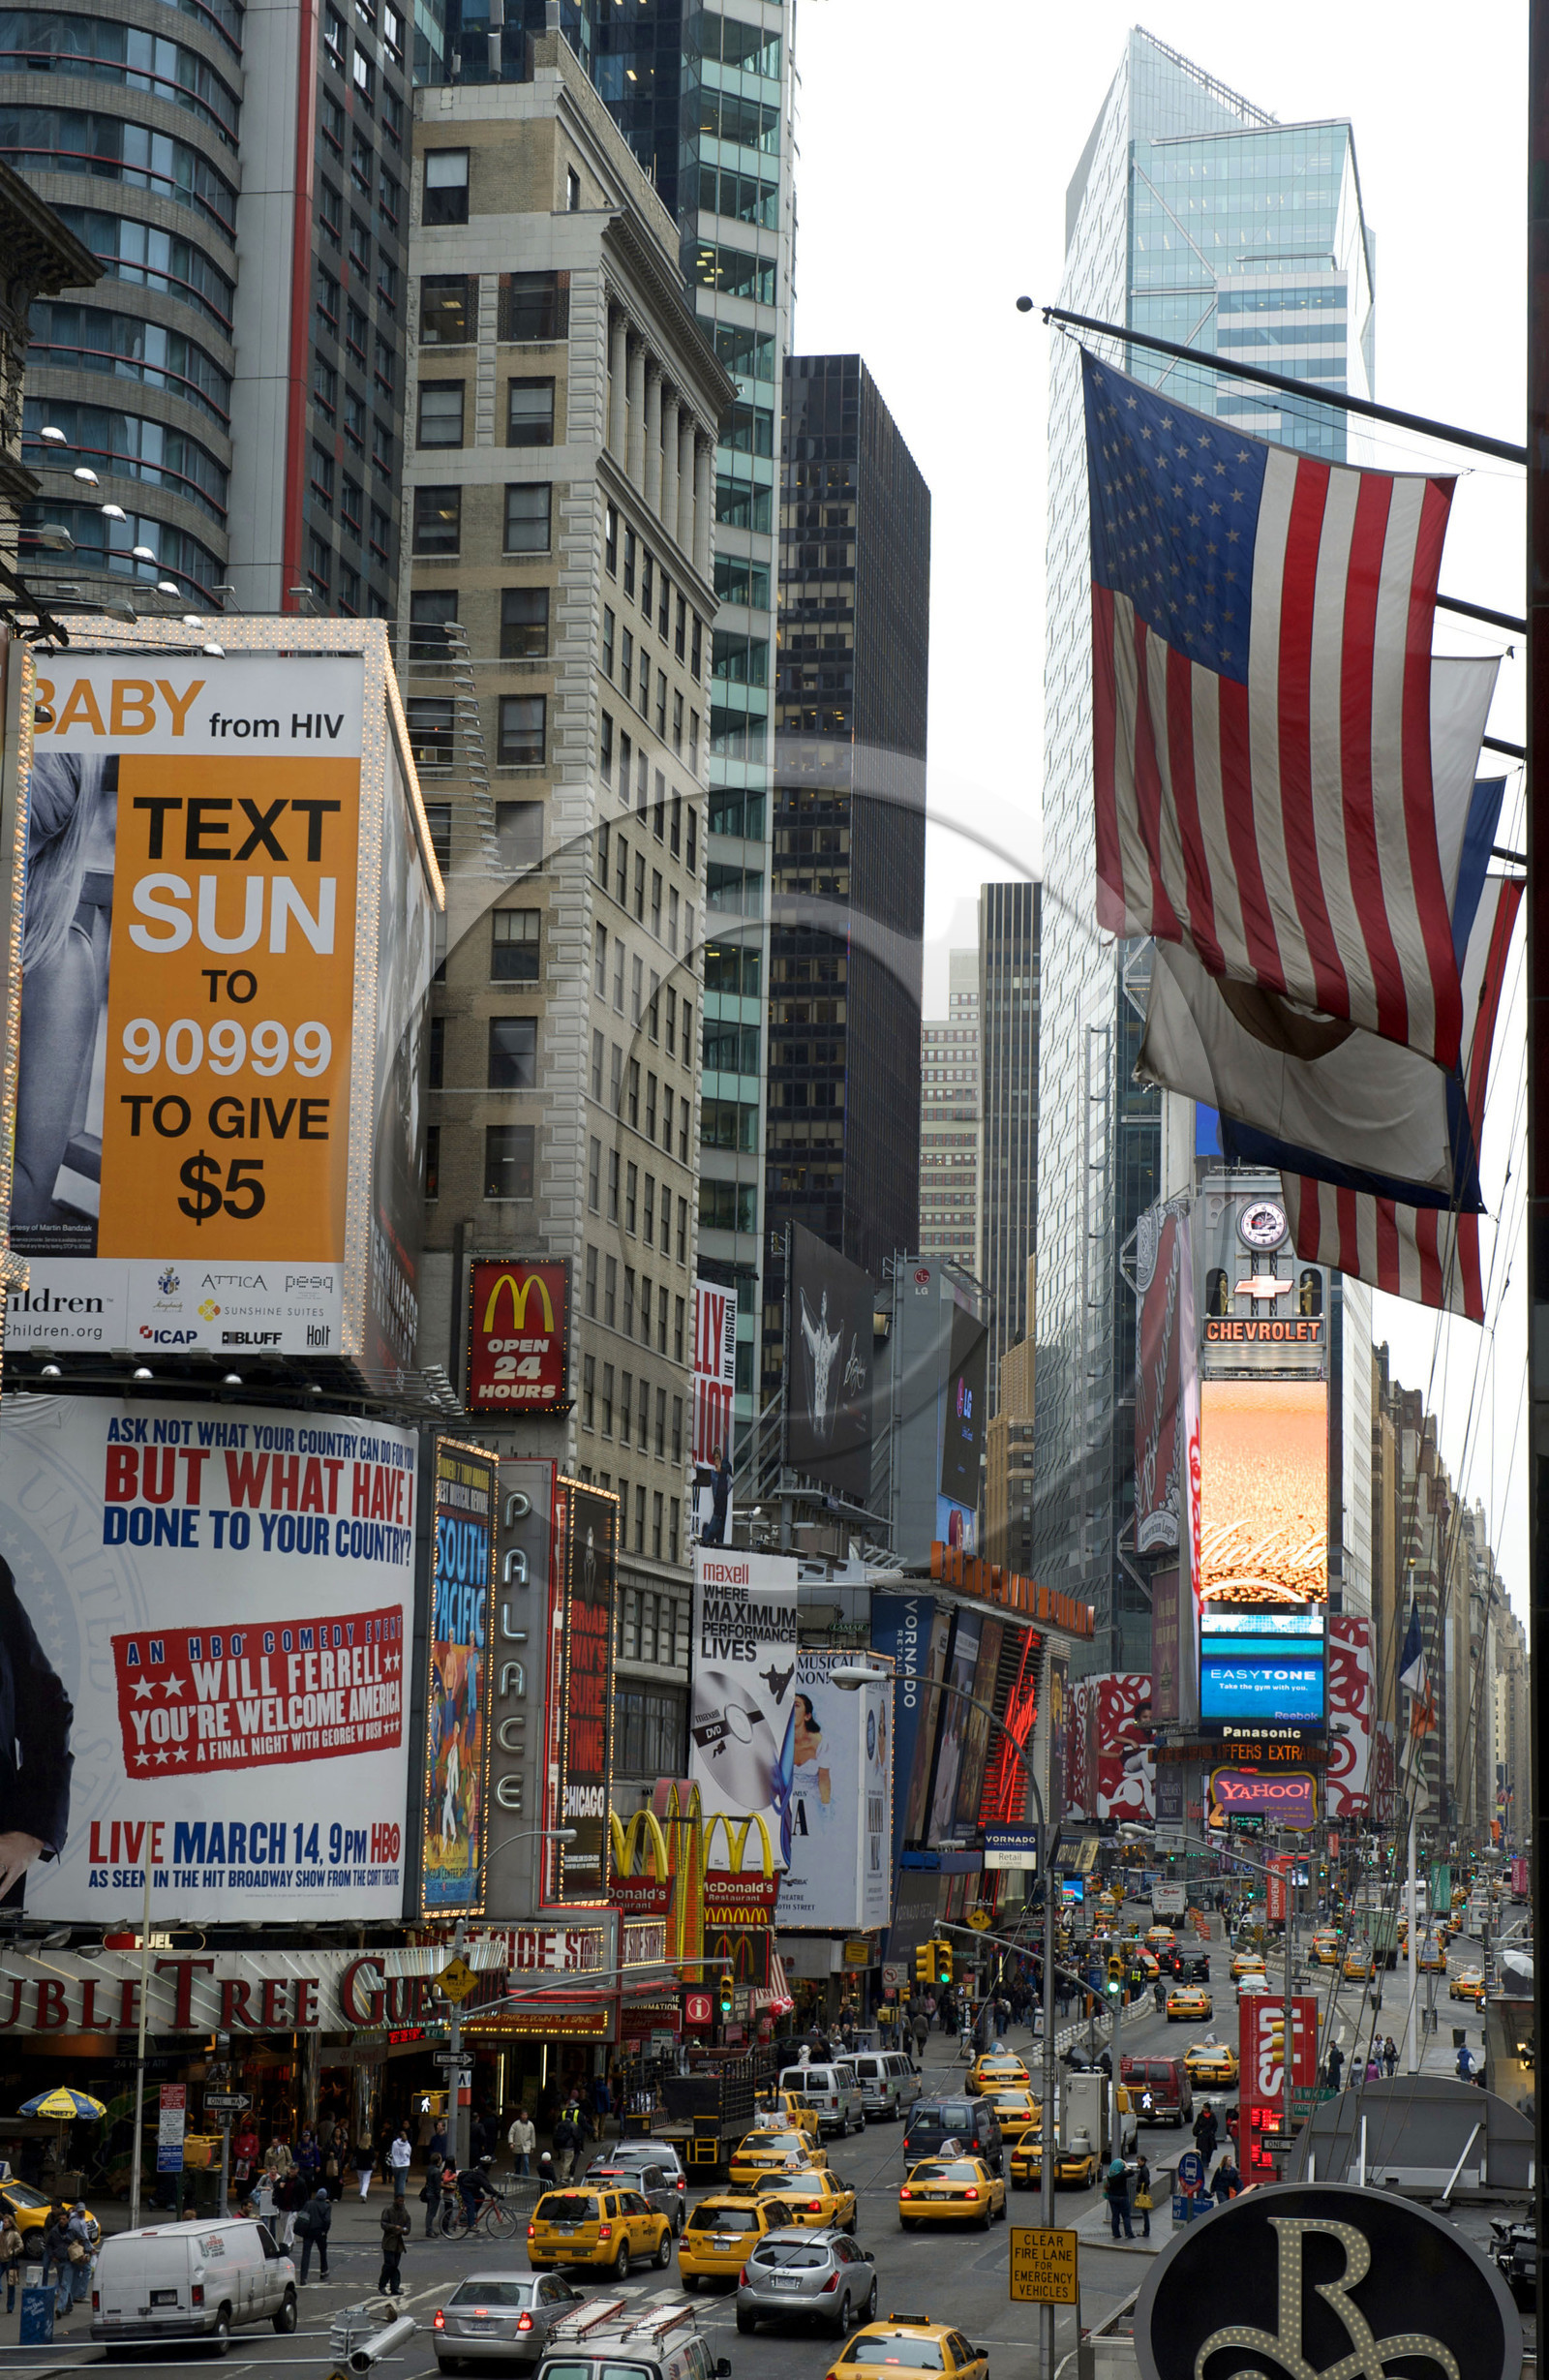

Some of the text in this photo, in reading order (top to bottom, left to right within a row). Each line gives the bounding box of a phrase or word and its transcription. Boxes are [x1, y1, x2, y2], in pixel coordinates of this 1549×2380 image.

[34, 678, 345, 739] BABY from HIV
[133, 797, 341, 862] TEXT
[128, 872, 337, 955] SUN
[201, 969, 258, 1004] TO
[122, 1018, 333, 1078] 90999
[120, 1095, 330, 1140] TO GIVE
[177, 1149, 265, 1226] $5
[200, 1274, 268, 1291] ATTICA
[915, 1287, 929, 1296] LG
[225, 1306, 324, 1317] SUNSHINE SUITES
[154, 1329, 197, 1344] ICAP
[235, 1331, 283, 1345] BLUFF
[306, 1325, 331, 1346] Holt
[724, 1298, 736, 1380] THE MUSICAL
[1206, 1322, 1321, 1341] CHEVROLET
[487, 1338, 549, 1353] OPEN
[493, 1356, 542, 1380] 24
[478, 1384, 557, 1399] HOURS
[107, 1418, 414, 1470] ASK NOT WHAT YOUR COUNTRY CAN DO FOR YOU
[104, 1445, 413, 1527] BUT WHAT HAVE I
[103, 1507, 411, 1567] DONE TO YOUR COUNTRY?
[437, 1515, 488, 1586] SOUTH
[703, 1562, 749, 1585] maxell
[704, 1584, 749, 1602] WHERE
[434, 1578, 486, 1647] PACIFIC
[702, 1600, 797, 1629] MAXIMUM
[127, 1639, 166, 1666] AN
[263, 1623, 354, 1654] COMEDY
[365, 1616, 402, 1642] EVENT
[702, 1623, 796, 1644] PERFORMANCE
[495, 1490, 532, 1811] PALACE
[701, 1636, 757, 1663] LIVES
[903, 1599, 918, 1708] VORNADO
[192, 1644, 382, 1702] WILL FERRELL
[1210, 1669, 1317, 1680] EASYTONE
[570, 1672, 604, 1717] SURE
[129, 1680, 401, 1747] YOU'RE WELCOME AMERICA
[695, 1709, 720, 1724] maxell
[1274, 1711, 1318, 1721] Reebok
[197, 1722, 382, 1762] A FINAL NIGHT WITH GEORGE W BUSH
[706, 1725, 722, 1740] DVD
[1223, 1726, 1301, 1739] Panasonic
[569, 1718, 603, 1773] THING
[563, 1785, 604, 1818] CHICAGO
[1219, 1781, 1311, 1800] YAHOO!
[89, 1820, 401, 1867] LIVE MARCH 14, HBO
[998, 1852, 1022, 1861] Retail
[89, 1869, 400, 1888] AS SEEN IN THE HIT BROADWAY SHOW FROM THE CORT THEATRE
[607, 1887, 667, 1902] Donald's
[709, 1893, 761, 1903] Restaurant
[135, 1934, 173, 1949] FUEL
[154, 1957, 320, 2030] TREE
[1023, 2234, 1064, 2247] CLEAR
[1016, 2247, 1073, 2261] FIRE LANE
[1015, 2271, 1073, 2284] EMERGENCY
[1035, 2261, 1052, 2271] FOR
[1019, 2285, 1069, 2299] VEHICLES
